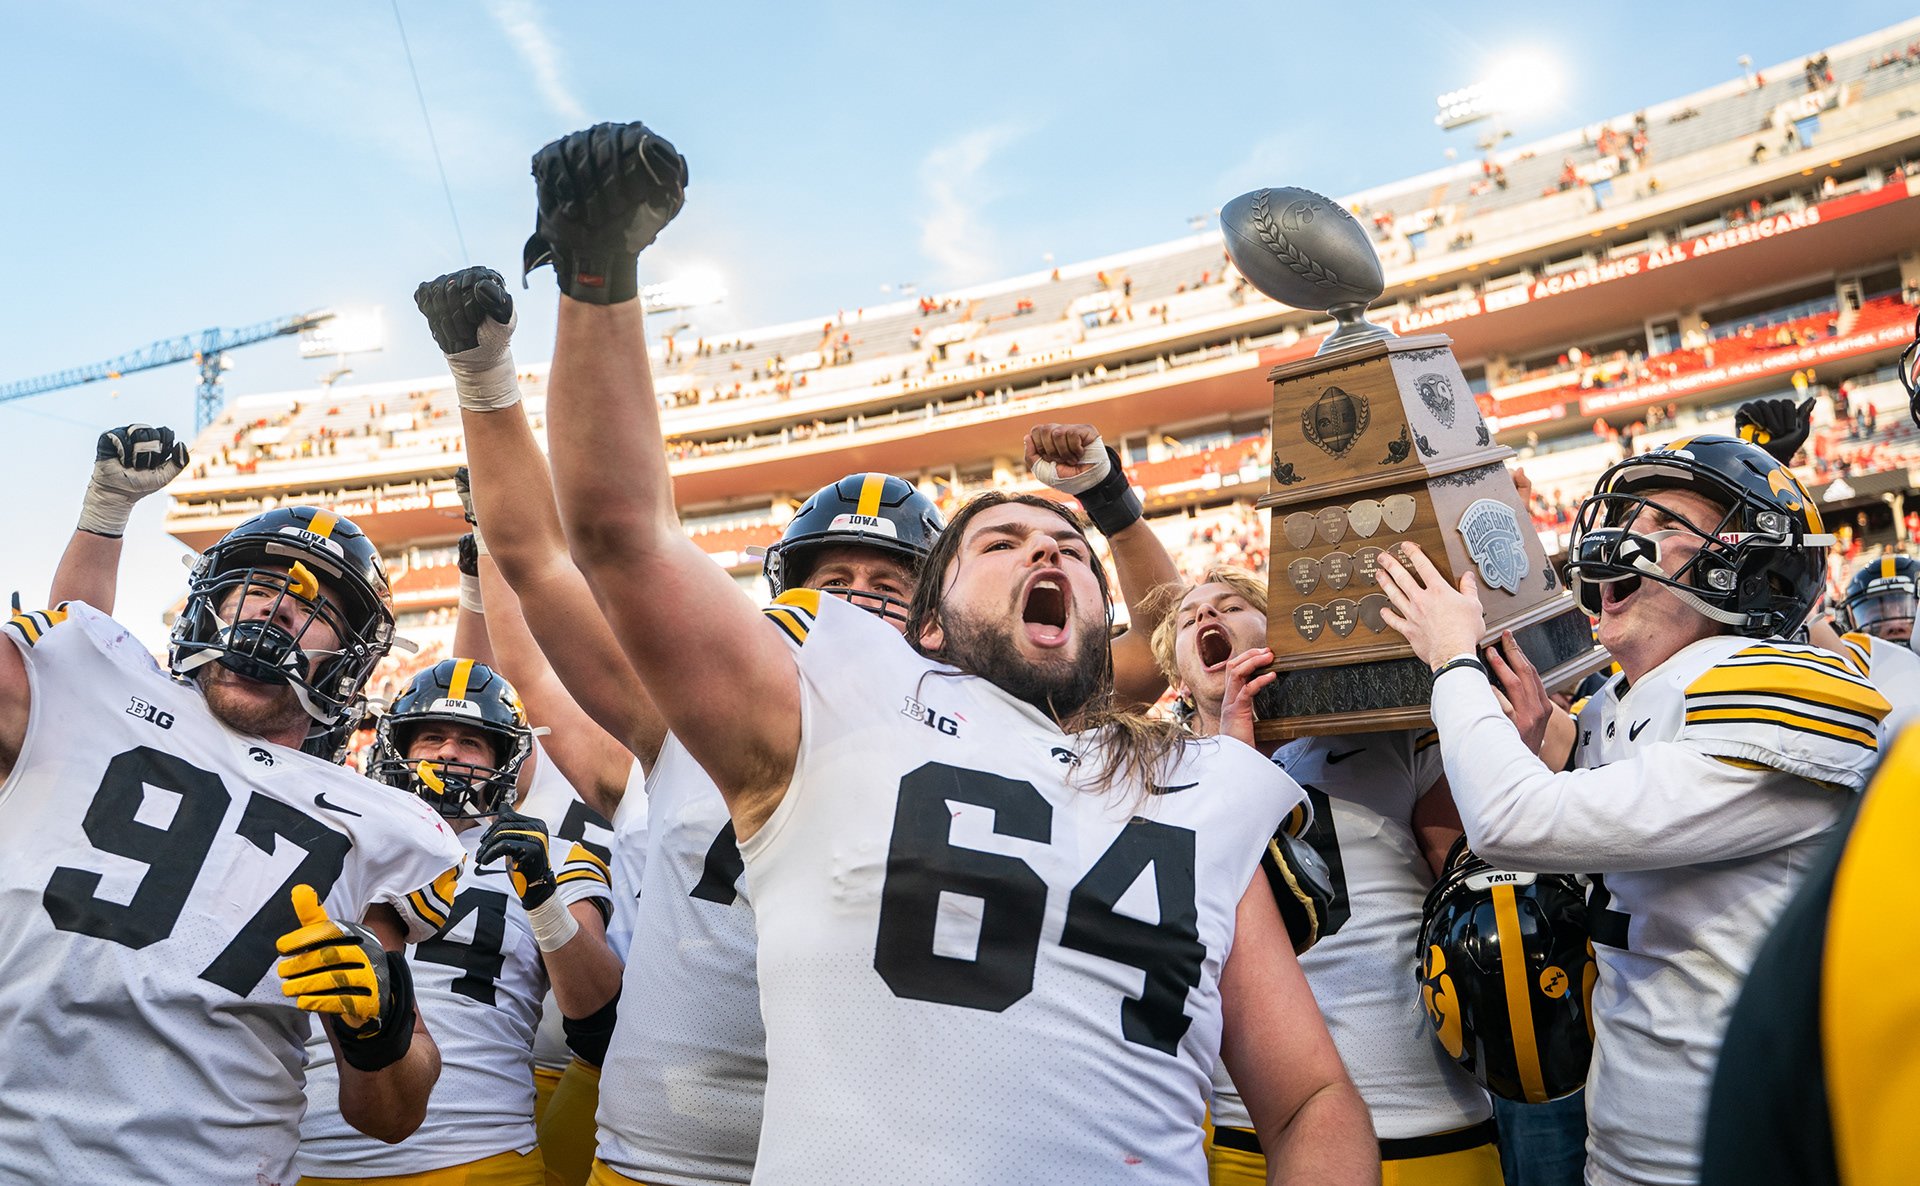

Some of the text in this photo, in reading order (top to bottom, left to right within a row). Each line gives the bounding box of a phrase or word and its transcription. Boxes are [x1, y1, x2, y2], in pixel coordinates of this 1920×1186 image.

[1399, 299, 1482, 333] LEADING
[1533, 256, 1641, 299] ACADEMIC
[1647, 245, 1687, 270] ALL
[1693, 205, 1821, 257] AMERICANS
[849, 515, 879, 527] IOWA
[299, 529, 328, 546] IOWA
[1466, 511, 1494, 556] HEROES
[1489, 511, 1521, 541] GAME
[445, 699, 468, 709] IOWA
[42, 745, 354, 999] 97
[1486, 873, 1518, 884] IOWA
[874, 761, 1207, 1058] 64
[1543, 971, 1565, 994] ANF
